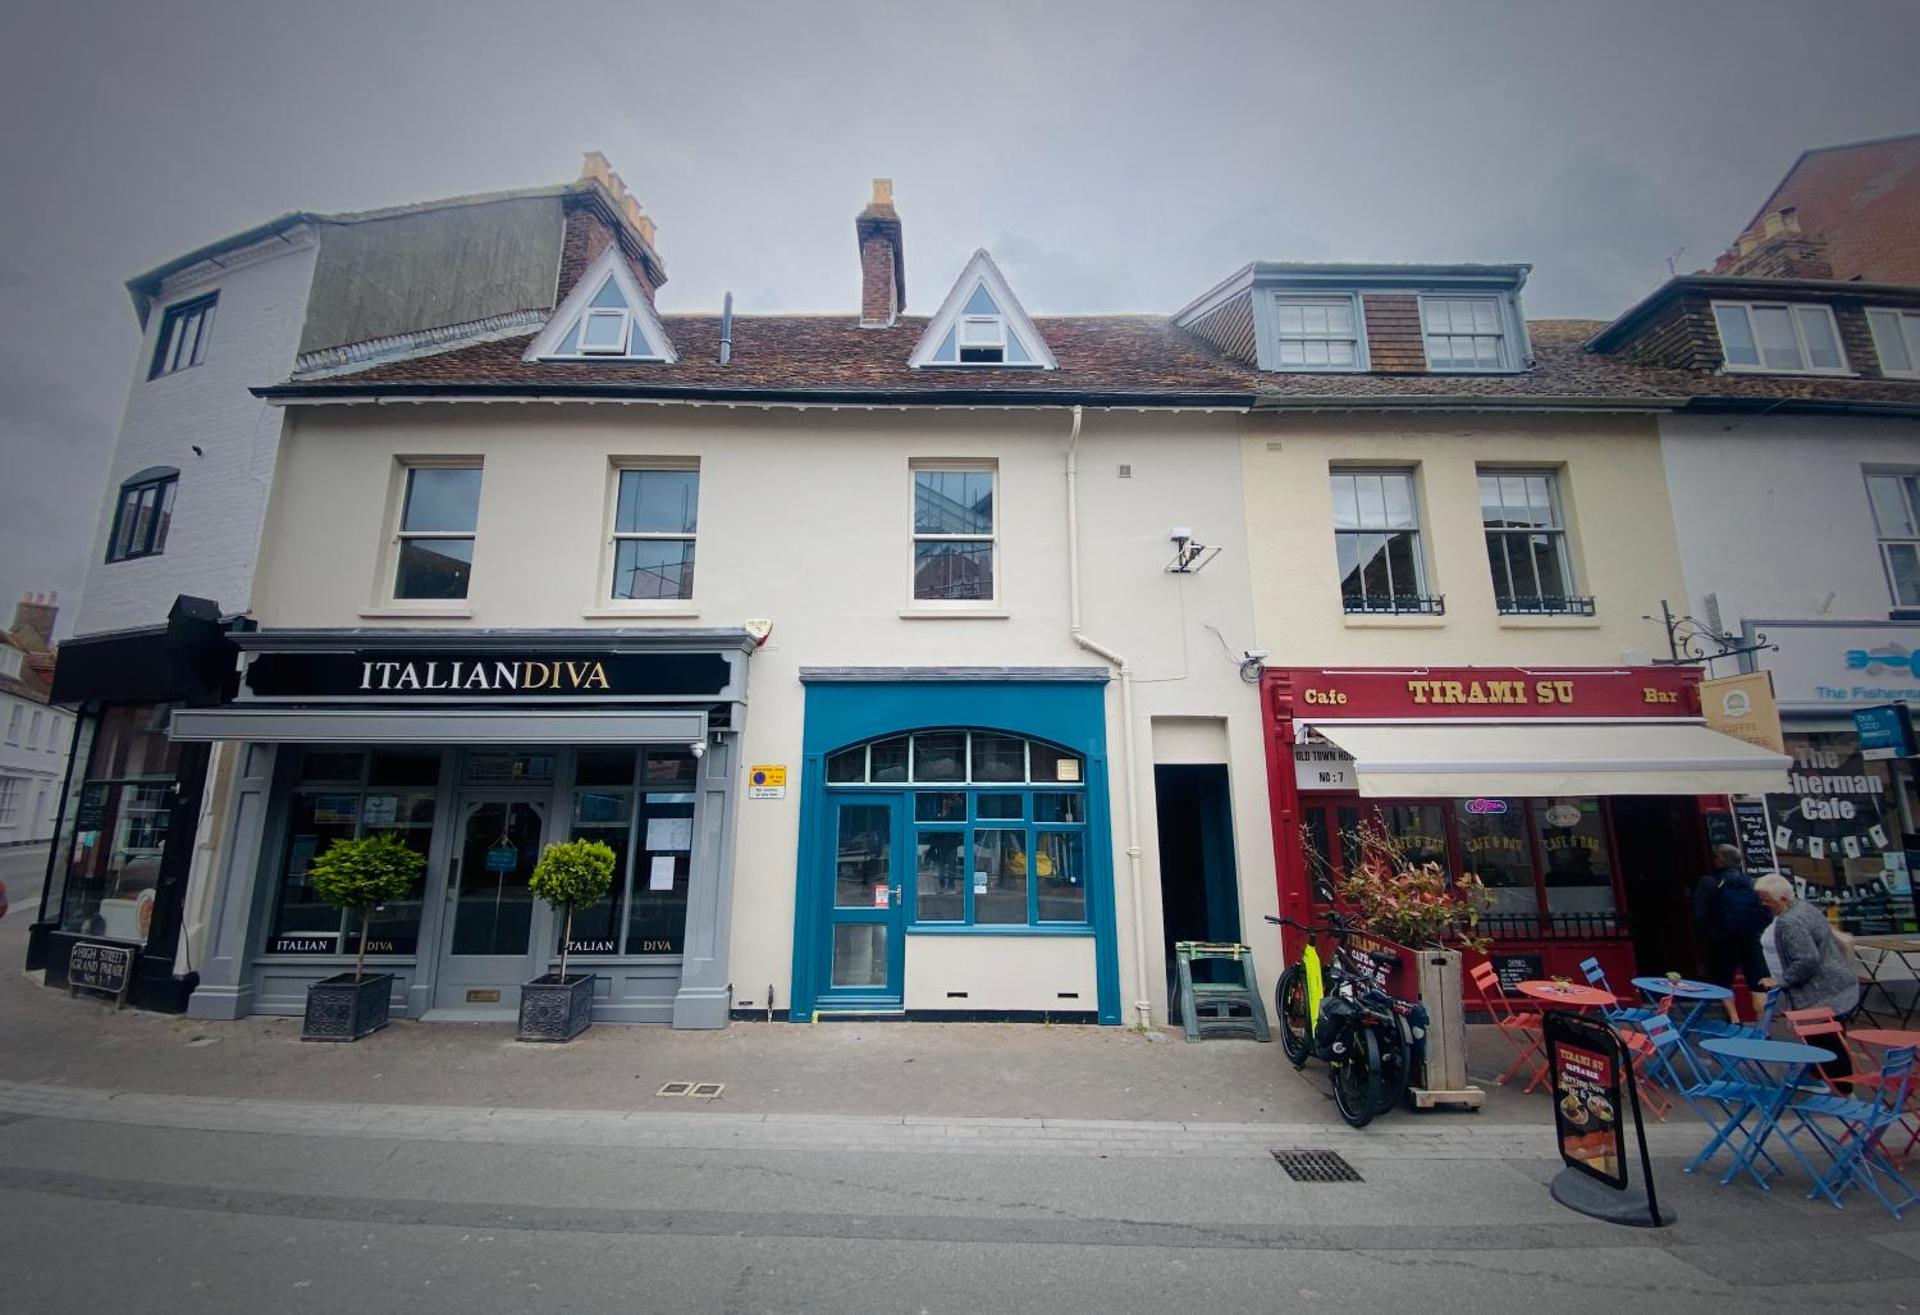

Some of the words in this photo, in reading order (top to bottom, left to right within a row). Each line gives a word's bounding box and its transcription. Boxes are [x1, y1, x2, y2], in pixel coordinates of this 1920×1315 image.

[1304, 688, 1348, 704] Cafe
[1408, 681, 1527, 704] TIRAMI
[1536, 681, 1574, 704] SU
[1643, 688, 1679, 704] Bar
[1816, 687, 1847, 699] The
[1313, 751, 1336, 761] TOWN
[1795, 746, 1841, 769] The
[1801, 797, 1856, 820] Cafe
[277, 940, 328, 951] ITALIAN
[366, 941, 393, 952] DIVA
[567, 941, 614, 951] TALIAN
[643, 941, 672, 951] DIVA
